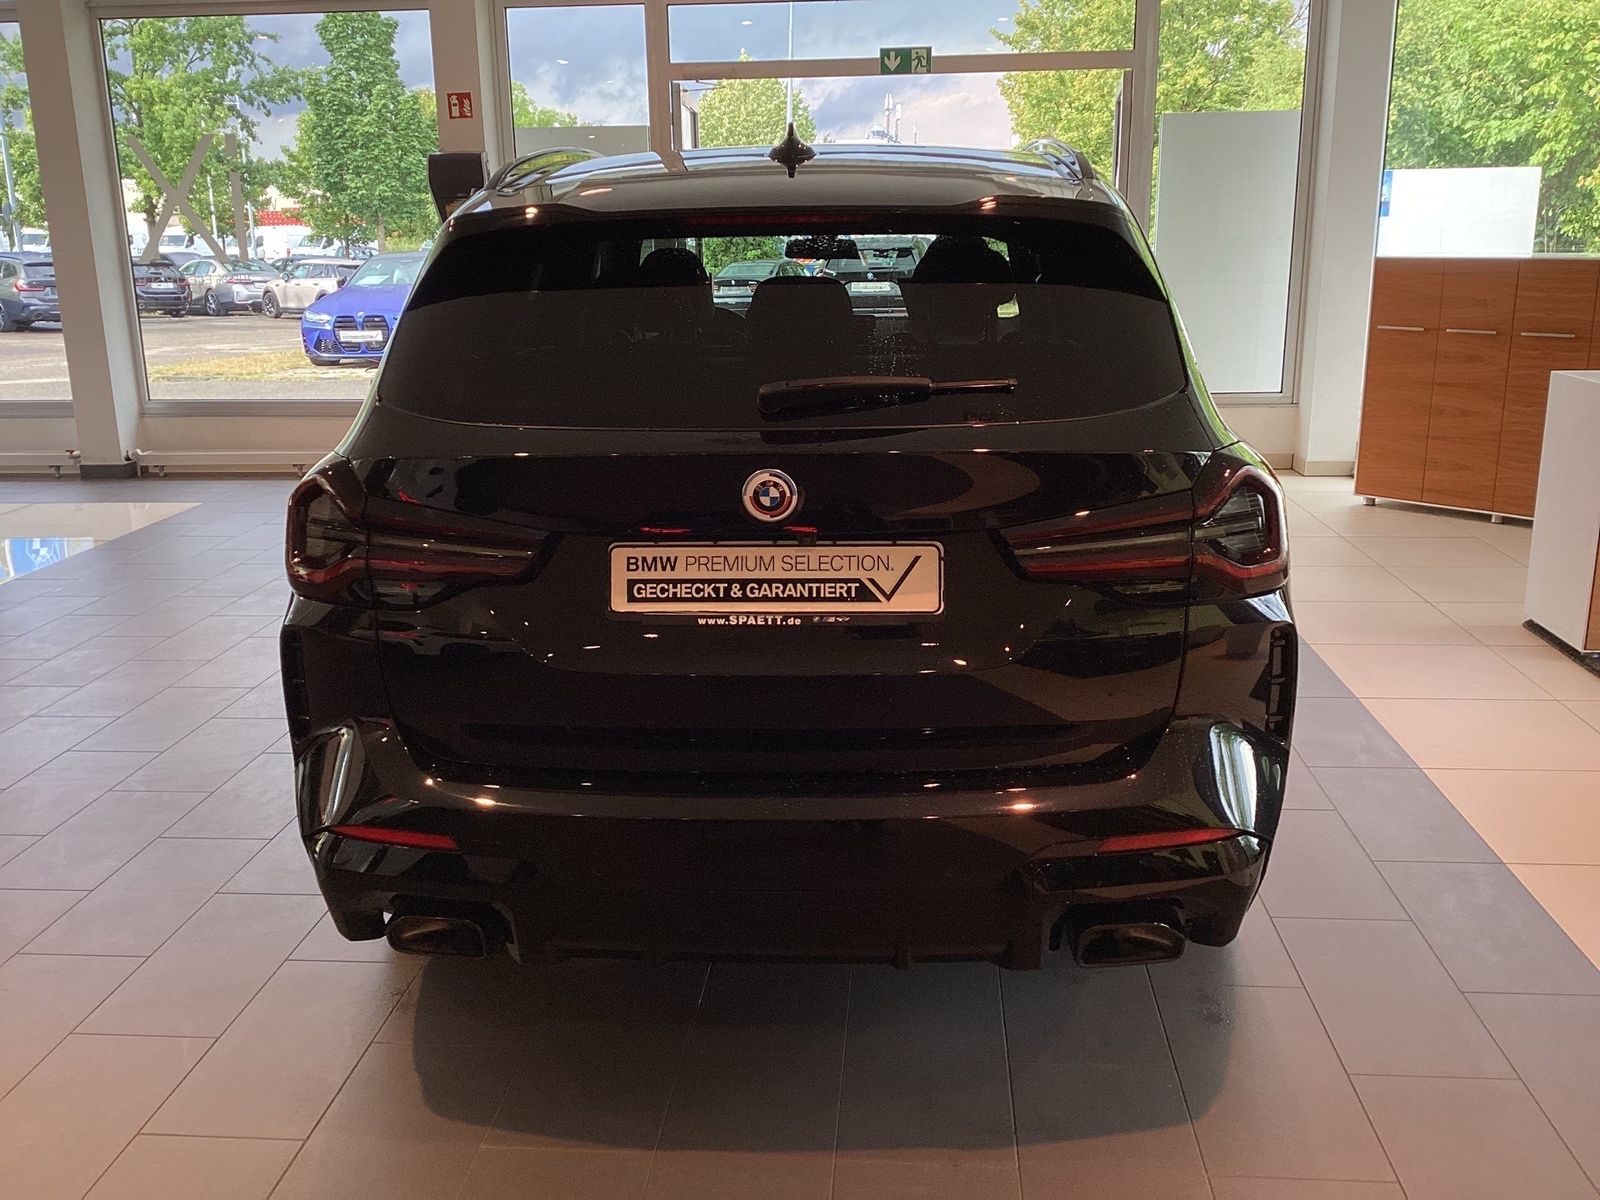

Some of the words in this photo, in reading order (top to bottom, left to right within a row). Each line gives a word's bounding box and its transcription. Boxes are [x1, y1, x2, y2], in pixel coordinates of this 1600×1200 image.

[626, 556, 678, 572] BMW
[685, 555, 775, 572] PREMIUM
[781, 555, 895, 572] SELECTION.
[633, 583, 728, 598] GECHECKT
[730, 583, 742, 598] &
[746, 583, 859, 598] GARANTIERT
[697, 615, 802, 625] www.SPAETT.de
